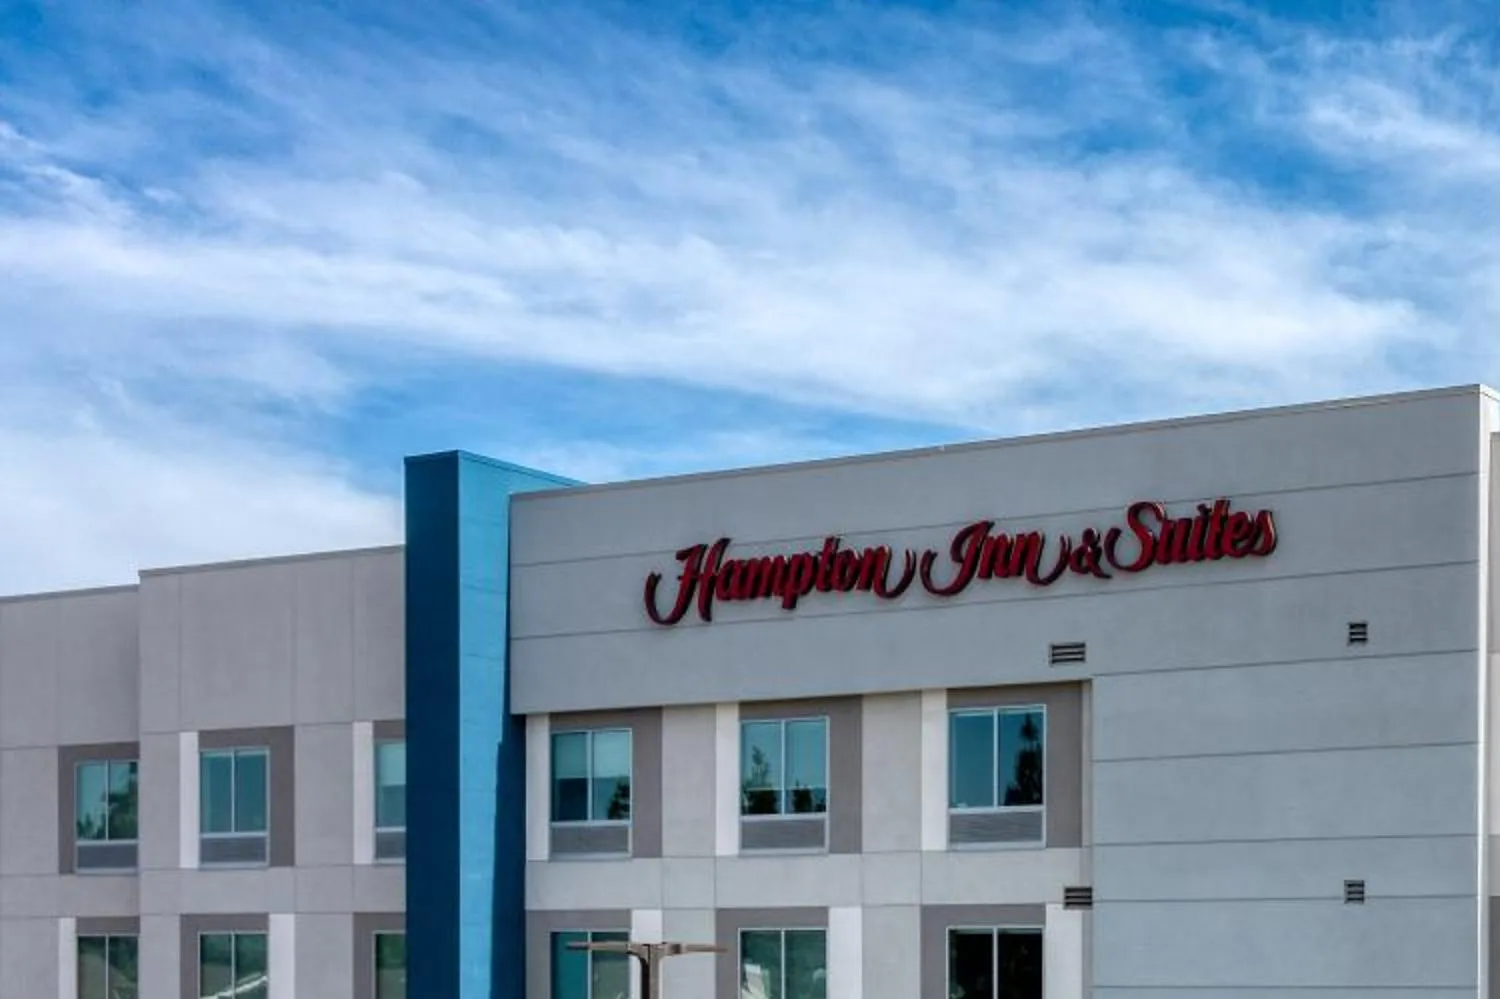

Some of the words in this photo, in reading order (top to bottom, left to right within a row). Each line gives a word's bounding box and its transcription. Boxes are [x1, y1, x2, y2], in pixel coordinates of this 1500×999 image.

[645, 537, 915, 626] Hampton
[920, 521, 1070, 597] Inn
[1067, 527, 1112, 579] &
[1106, 497, 1278, 572] Suites
